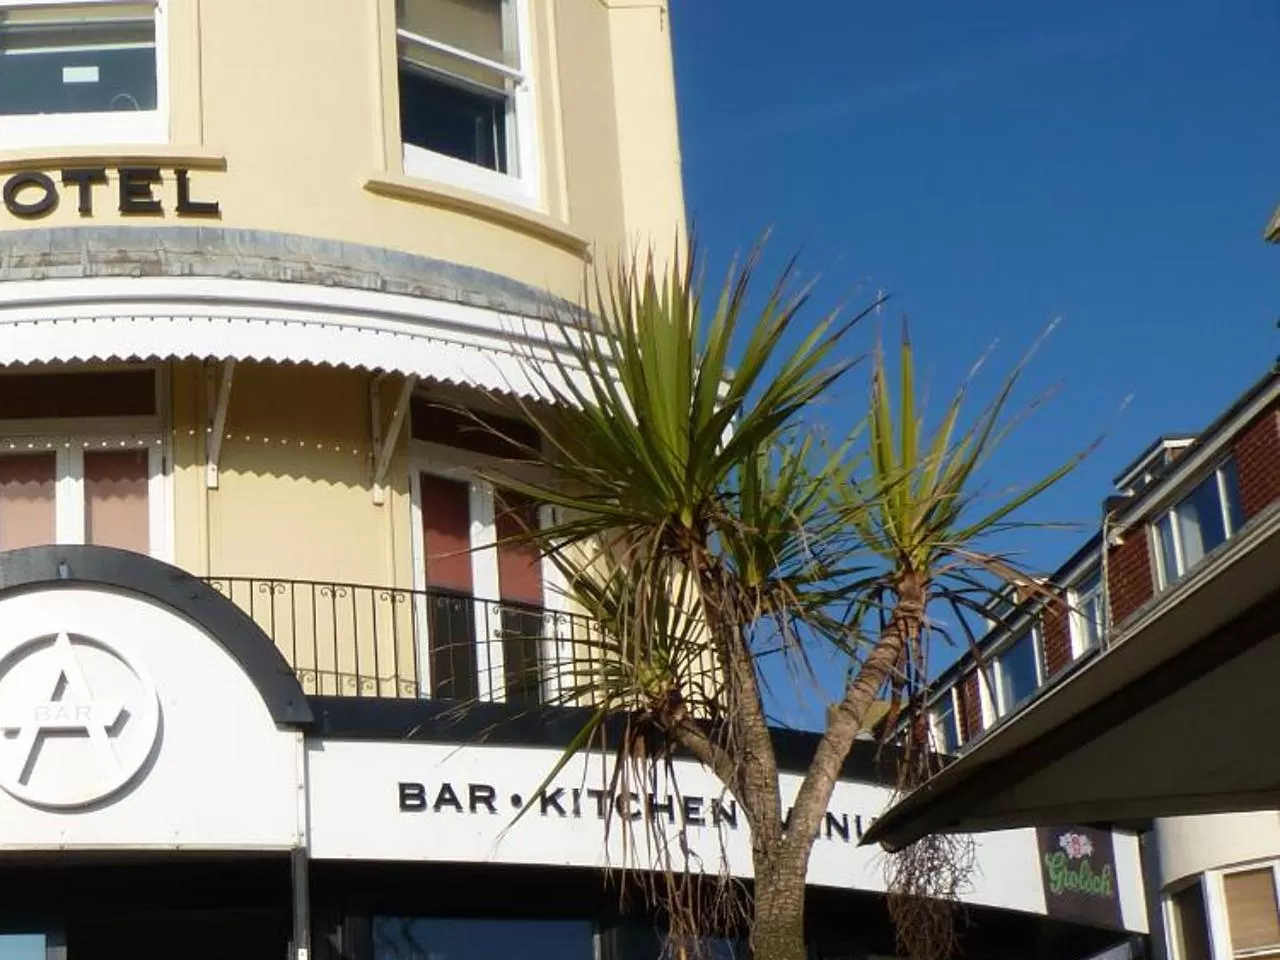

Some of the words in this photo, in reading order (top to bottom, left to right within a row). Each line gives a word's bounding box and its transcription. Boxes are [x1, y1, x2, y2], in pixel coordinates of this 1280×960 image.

[397, 781, 498, 814] BAR
[540, 786, 738, 829] KITCHEN
[1045, 852, 1113, 896] Grolsch
